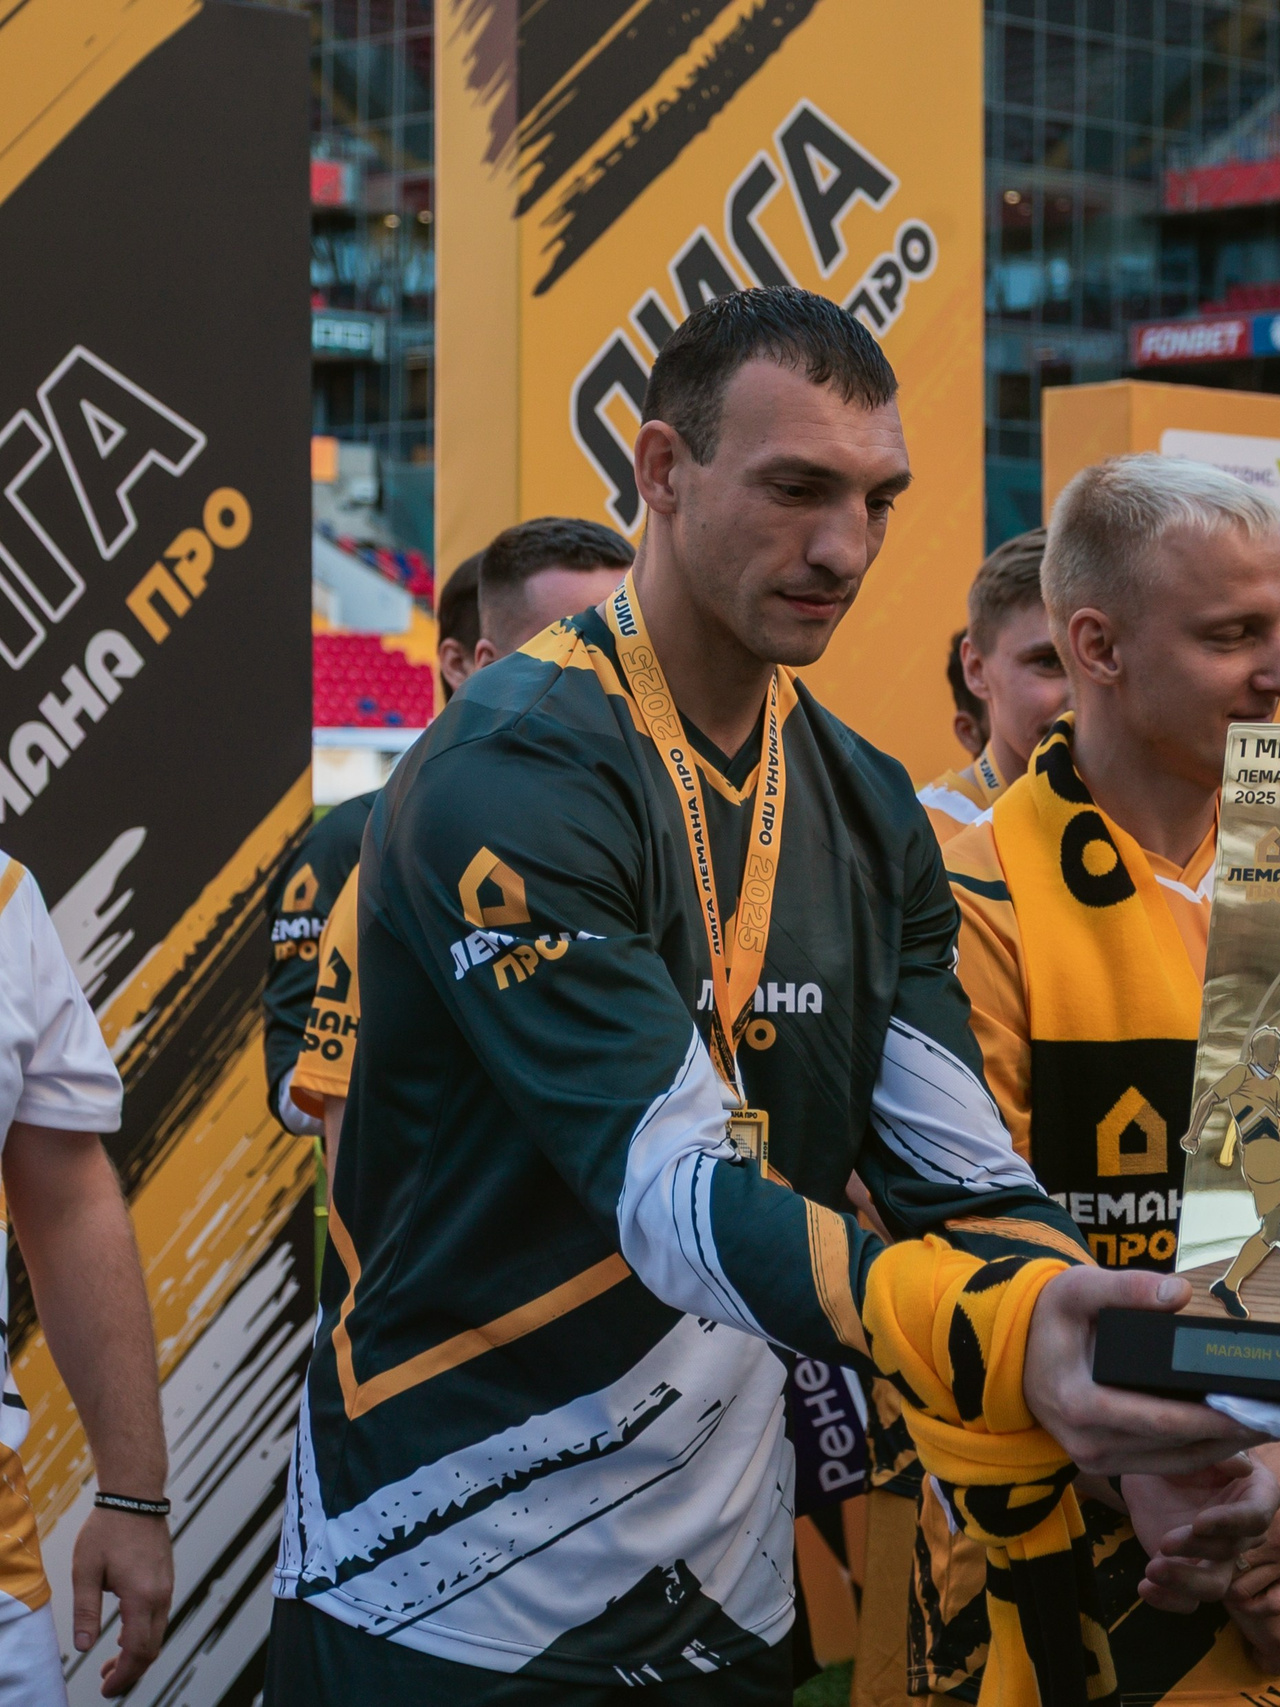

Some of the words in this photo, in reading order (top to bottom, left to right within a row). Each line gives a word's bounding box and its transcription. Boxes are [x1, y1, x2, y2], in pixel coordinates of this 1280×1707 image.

[1139, 321, 1246, 360] FONBET
[126, 487, 253, 645] ПРО
[613, 589, 638, 637] ЛИГА
[621, 646, 681, 740] 2025
[670, 748, 695, 791] ПРО
[764, 711, 779, 796] ЛЕМАНА
[1234, 790, 1276, 805] 2025
[688, 796, 712, 893] ЛЕМАНА
[759, 801, 775, 846] ПРО
[706, 898, 722, 955] ЛИГА
[738, 854, 775, 953] 2025
[493, 940, 569, 990] ПРО
[1088, 1229, 1177, 1265] ПРО
[1206, 1343, 1272, 1360] МАГАЗИН
[794, 1353, 867, 1493] Рене
